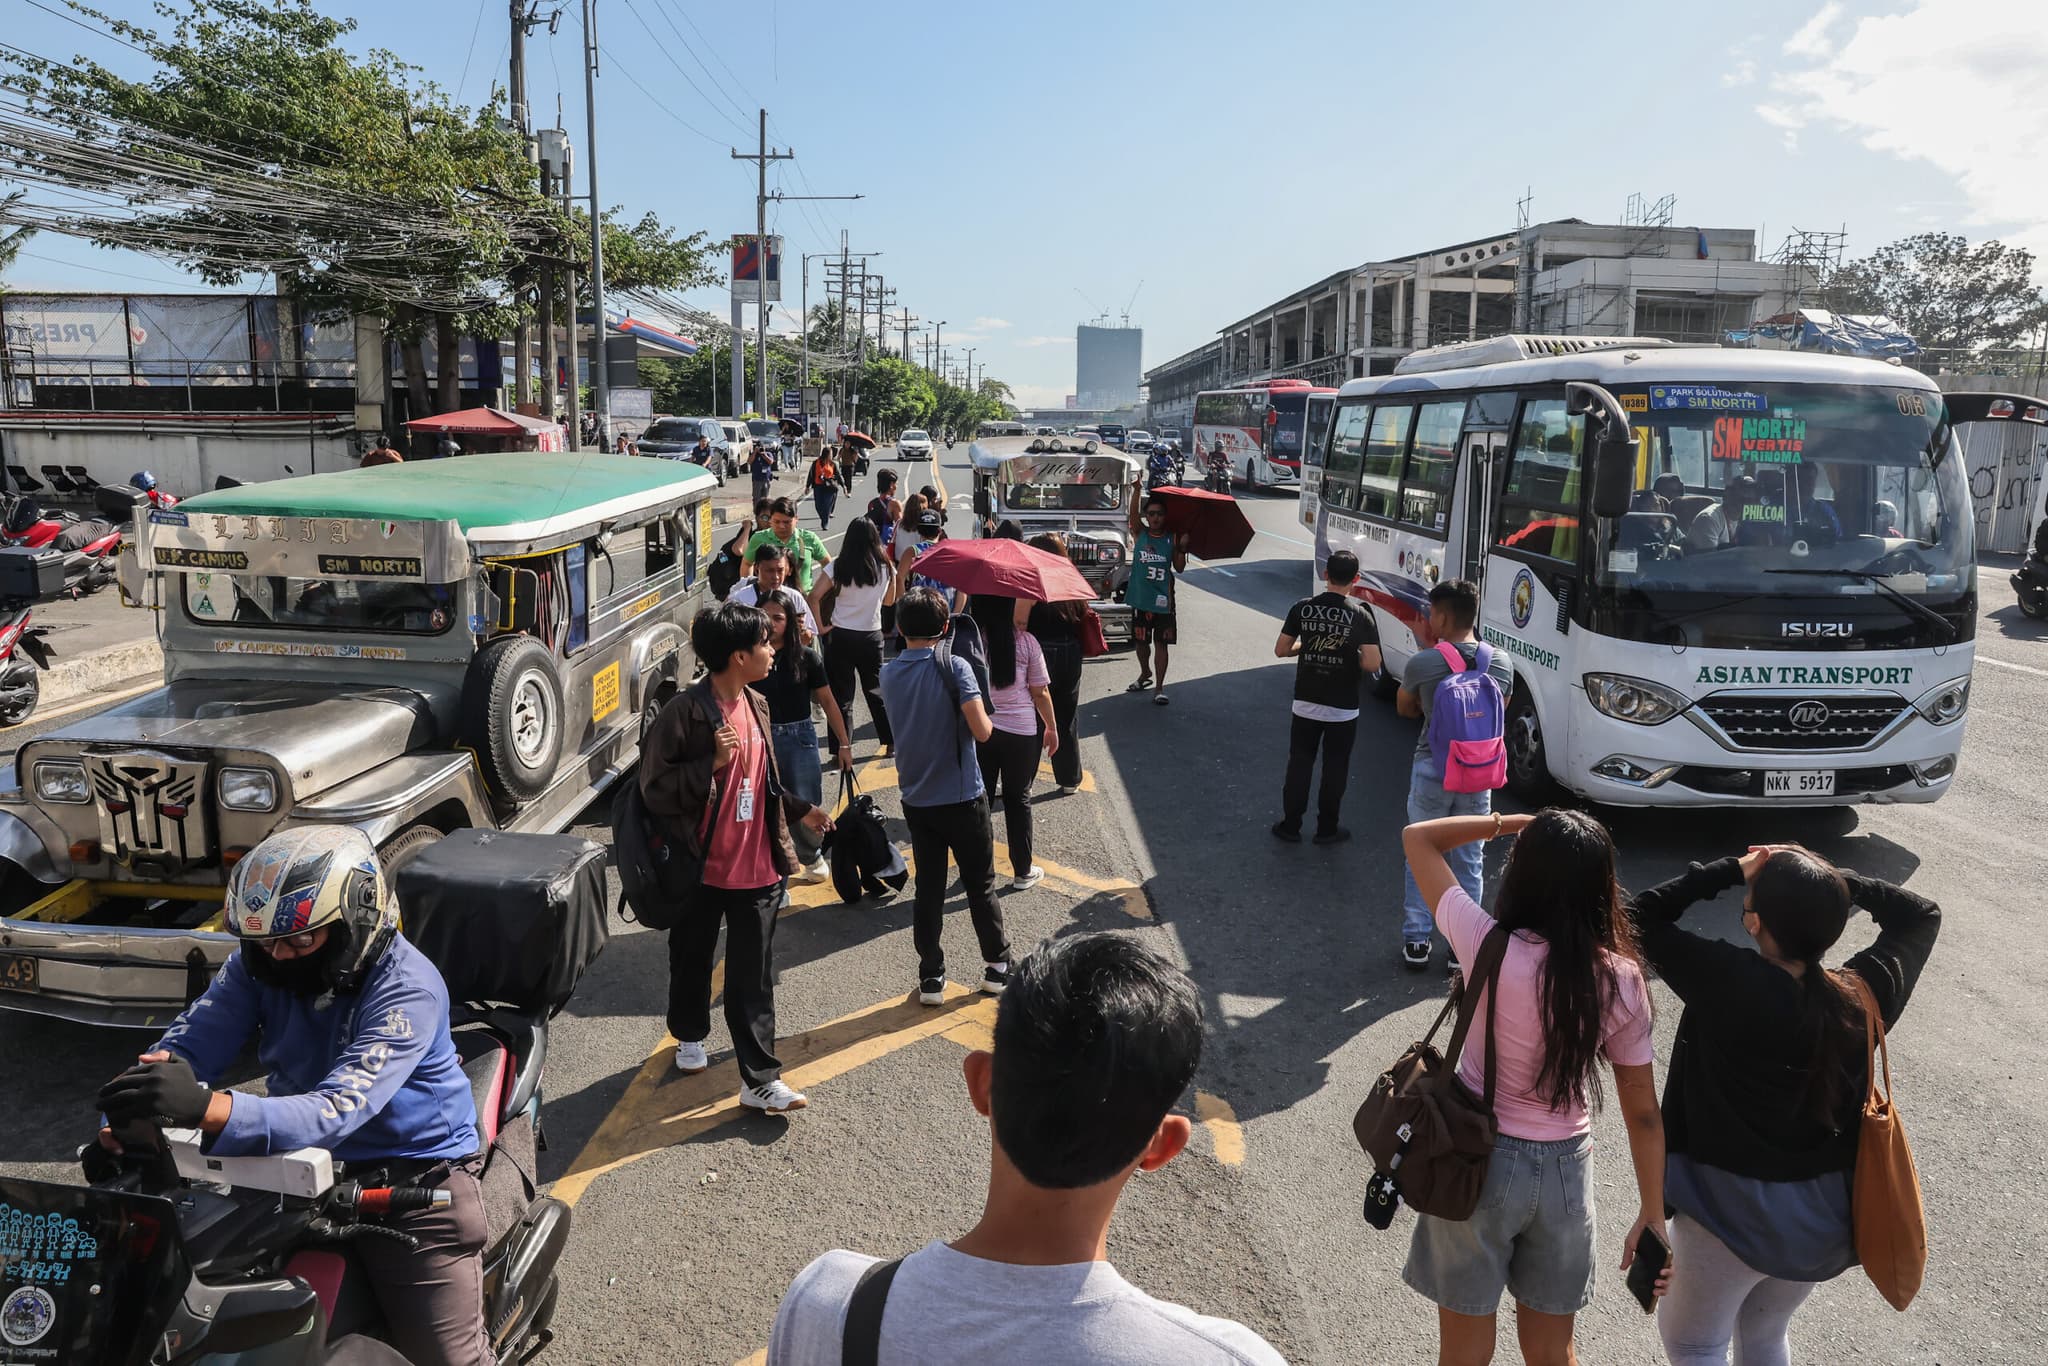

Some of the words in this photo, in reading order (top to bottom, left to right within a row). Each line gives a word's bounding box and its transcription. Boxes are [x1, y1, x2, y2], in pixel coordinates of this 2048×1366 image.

[1671, 388, 1694, 397] PARK
[1688, 397, 1708, 407] SM
[1711, 397, 1757, 409] NORTH
[1712, 417, 1743, 459] SM
[1743, 418, 1806, 440] NORTH
[1743, 439, 1804, 451] VERTIS
[1741, 450, 1802, 464] TRINOMA
[1742, 504, 1784, 521] PHILCOA
[1371, 525, 1389, 544] NORTH
[189, 551, 247, 567] CAMPUS
[325, 558, 349, 571] SM
[360, 560, 417, 574] NORTH
[1146, 566, 1166, 581] 33
[1300, 604, 1354, 625] OXGN
[1301, 621, 1351, 637] HUSTLE
[1781, 622, 1853, 638] ISUZU
[339, 645, 360, 657] SM
[1483, 625, 1505, 648] ASIAN
[1505, 635, 1560, 671] TRANSPORT
[1696, 666, 1773, 683] ASIAN
[1777, 667, 1912, 684] TRANSPORT
[1767, 775, 1791, 791] NKK
[1800, 775, 1833, 790] 5917
